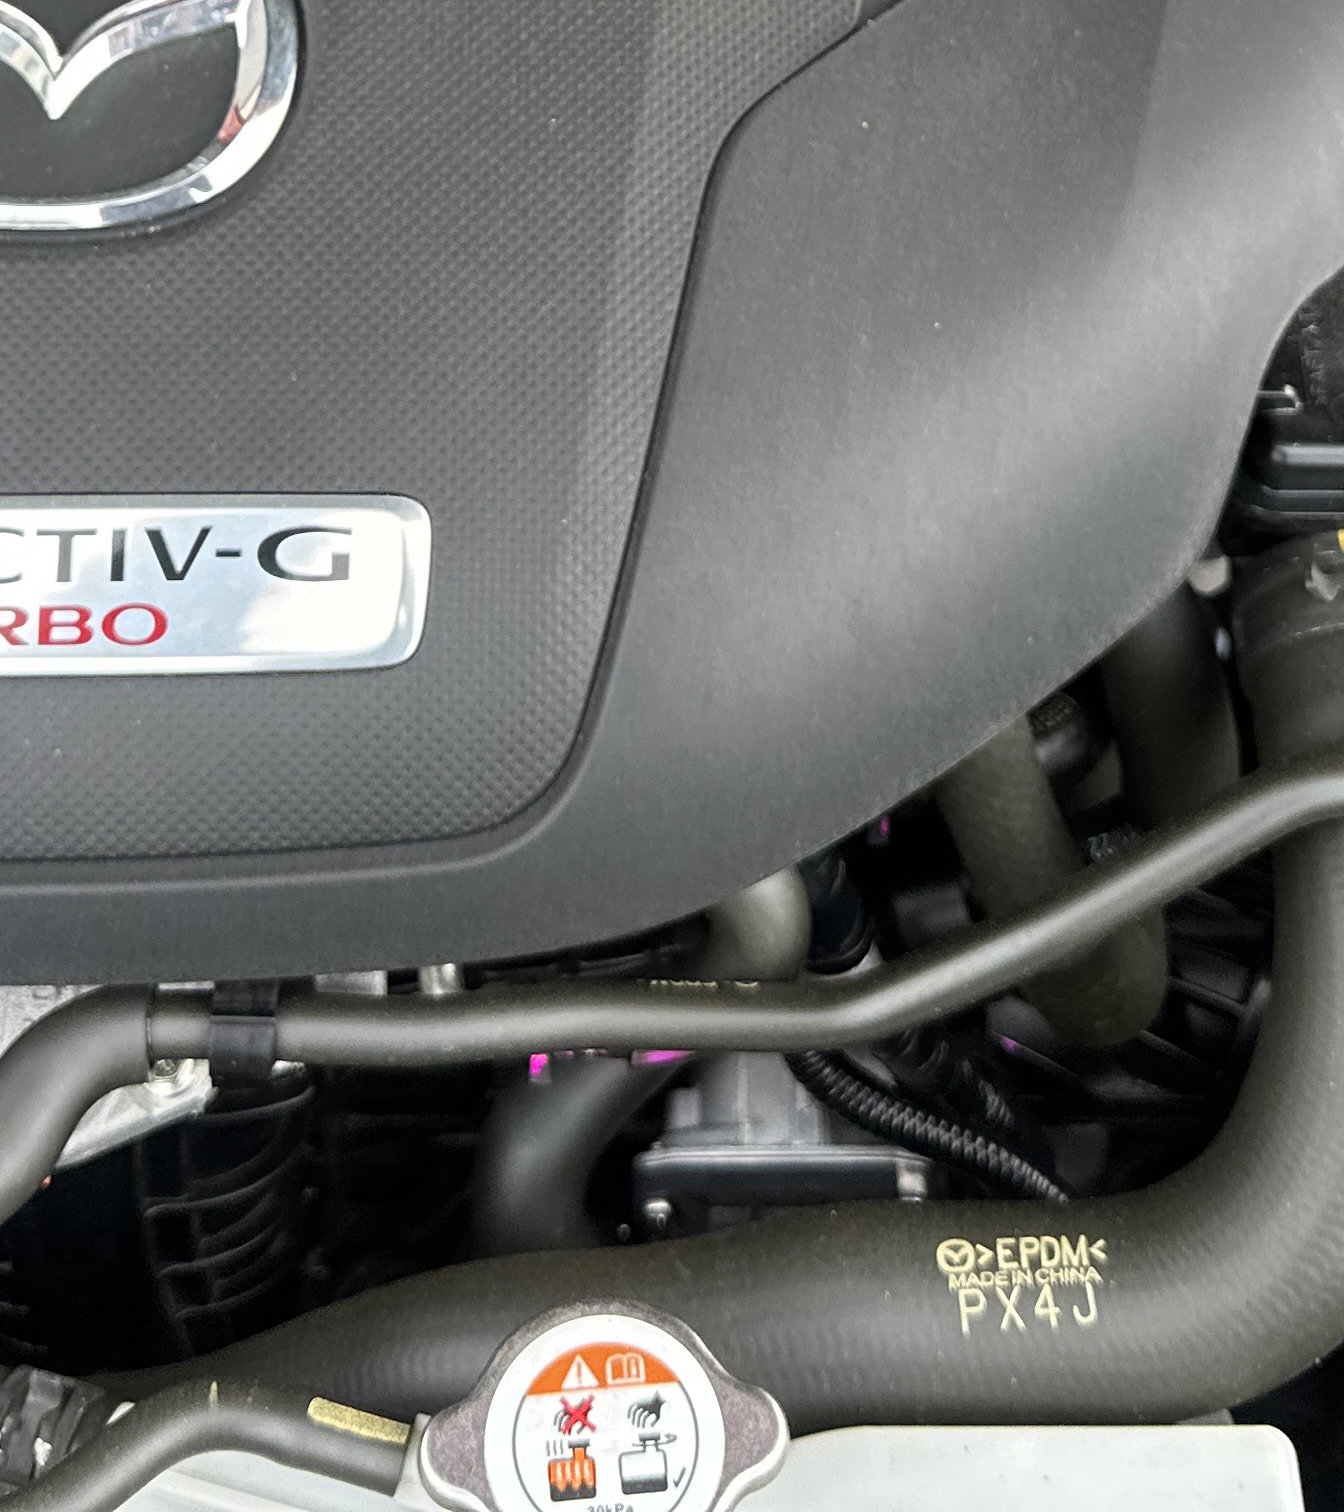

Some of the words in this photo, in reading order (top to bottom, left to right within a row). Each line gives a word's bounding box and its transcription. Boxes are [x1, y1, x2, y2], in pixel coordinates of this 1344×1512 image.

[948, 1271, 1010, 1293] MADE
[1011, 1268, 1035, 1289] IN
[1035, 1266, 1104, 1287] CHINA
